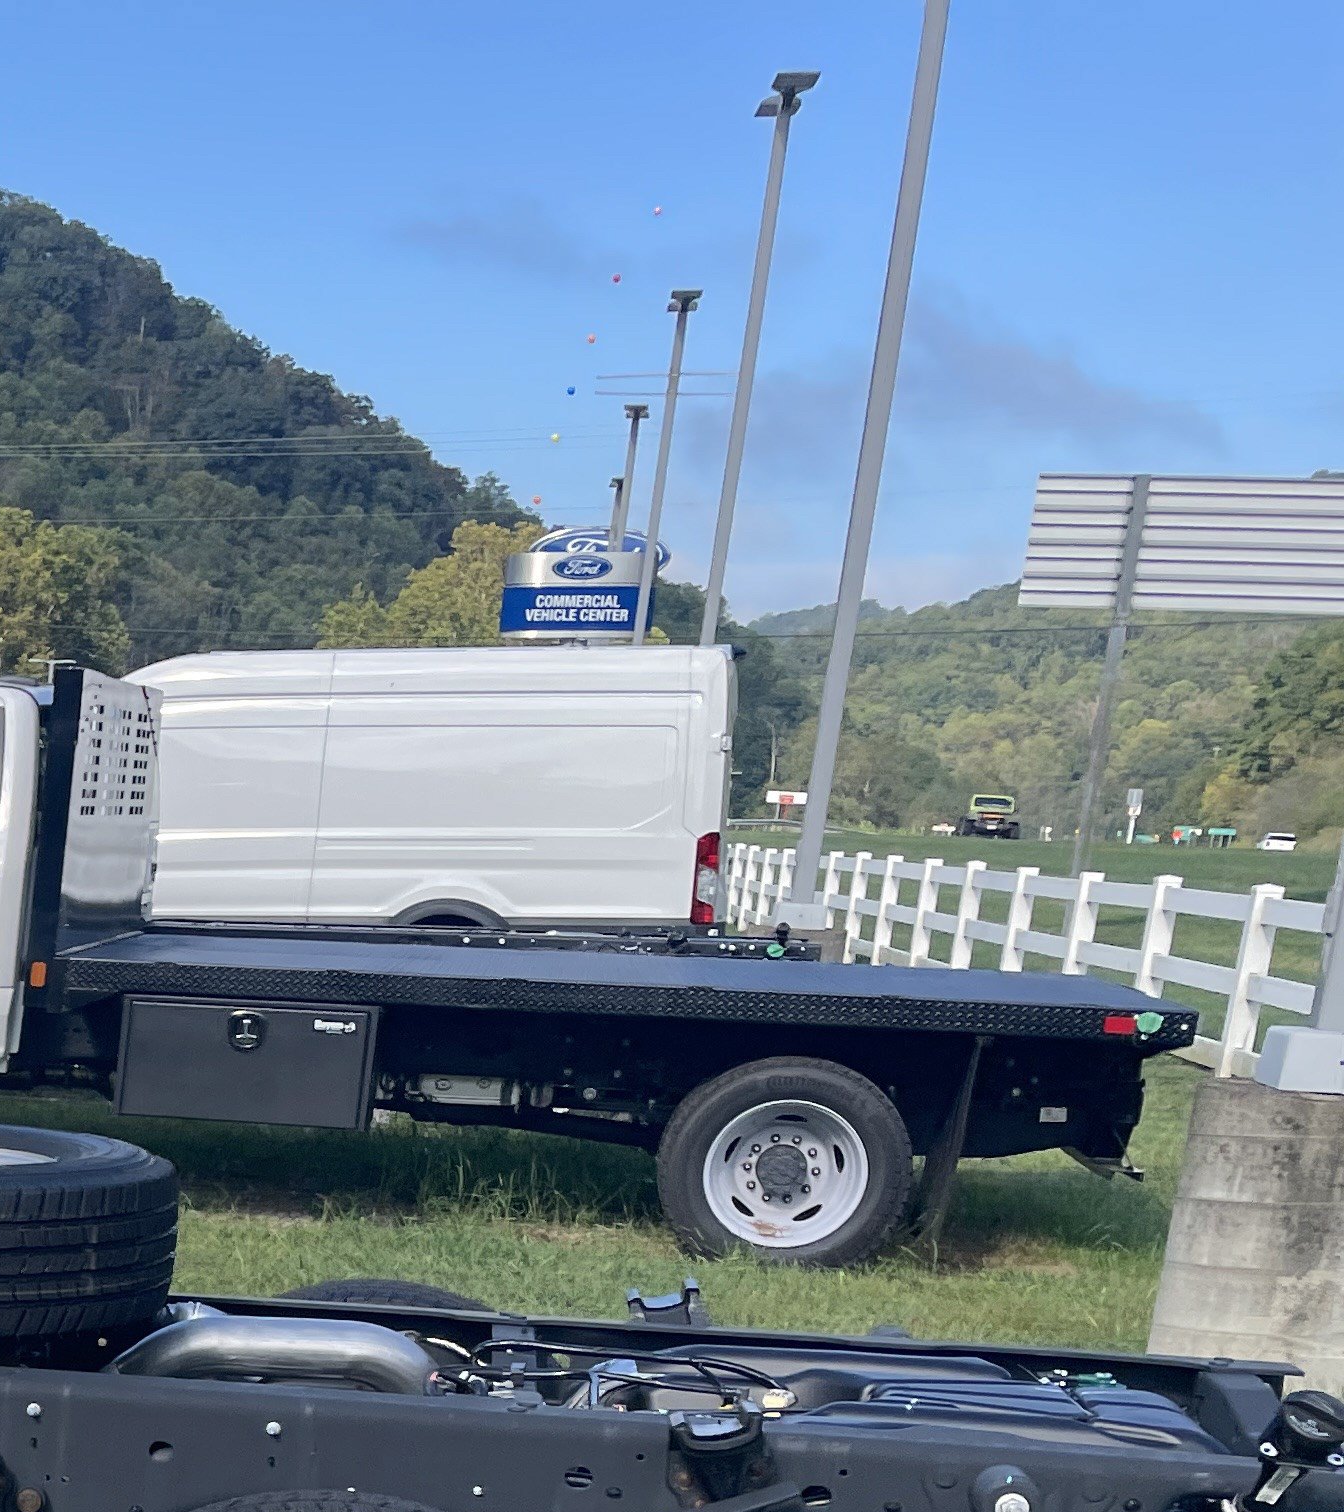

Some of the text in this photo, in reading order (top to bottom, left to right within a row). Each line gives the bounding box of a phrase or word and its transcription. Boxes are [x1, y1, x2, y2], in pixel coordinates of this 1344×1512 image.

[564, 561, 601, 575] Ford
[536, 595, 620, 608] COMMERCIAL
[525, 608, 629, 622] VEHICLE CENTER
